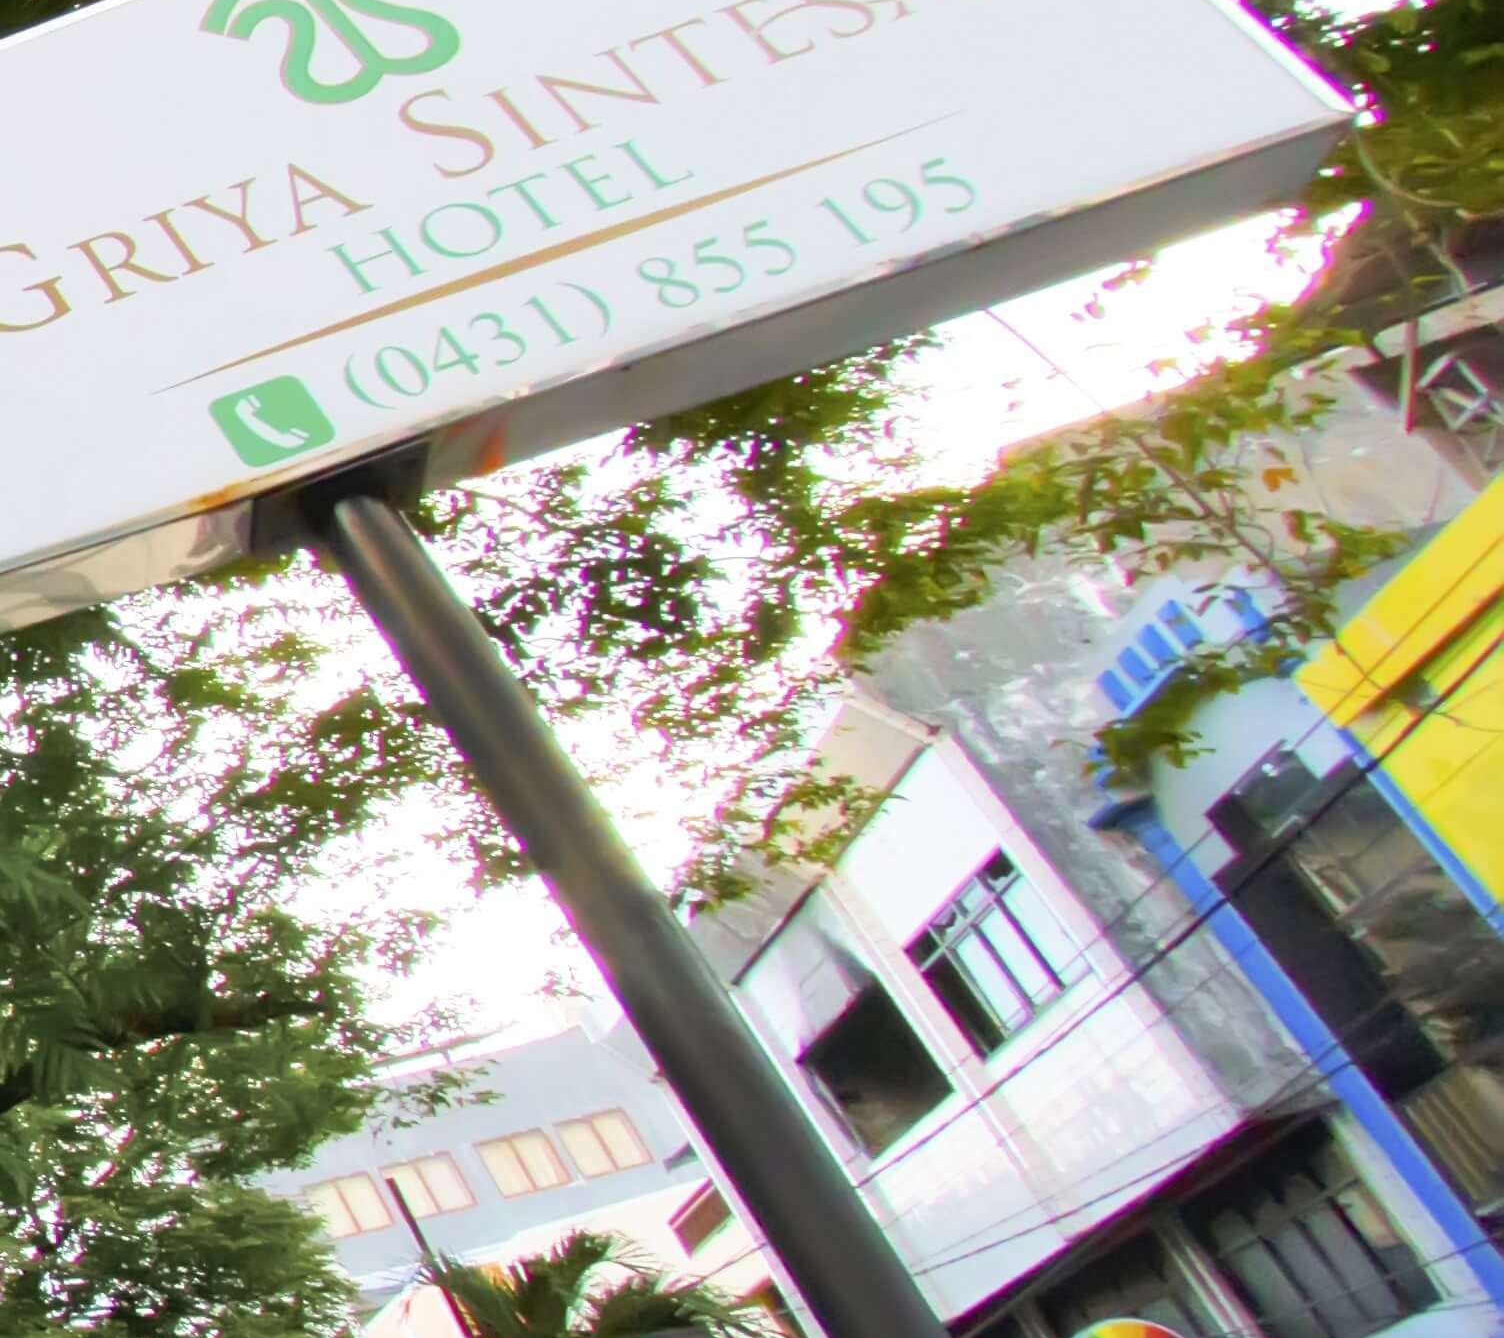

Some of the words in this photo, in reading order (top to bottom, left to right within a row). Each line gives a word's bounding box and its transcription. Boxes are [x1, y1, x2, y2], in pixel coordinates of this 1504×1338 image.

[326, 139, 693, 294] HOTEL
[343, 282, 613, 409] (0431)
[636, 221, 796, 308] 855
[819, 158, 976, 247] 195
